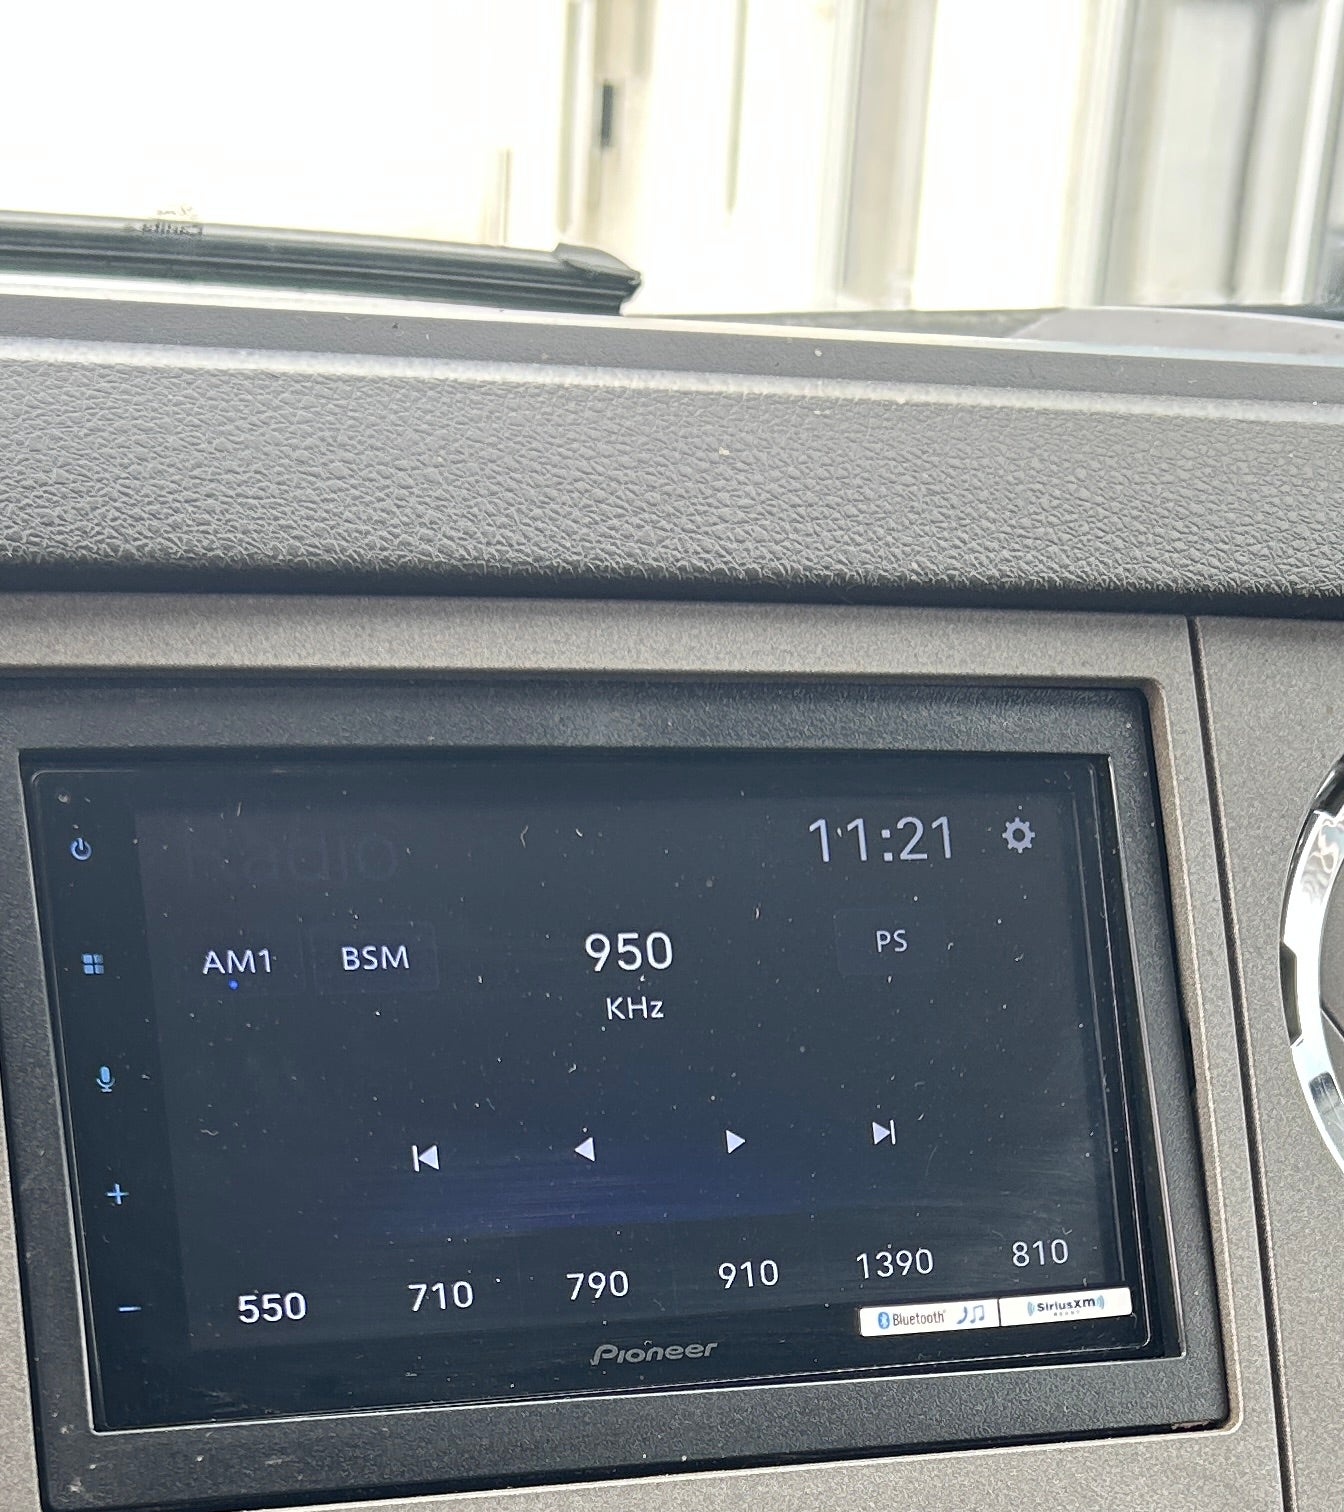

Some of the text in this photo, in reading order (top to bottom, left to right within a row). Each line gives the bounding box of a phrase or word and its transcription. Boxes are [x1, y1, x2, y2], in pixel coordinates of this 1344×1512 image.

[808, 815, 952, 863] 11:21
[584, 931, 674, 973] 950
[875, 929, 908, 953] PS
[202, 948, 272, 975] AM1
[340, 945, 410, 971] BSM
[605, 995, 665, 1021] KHz
[237, 1238, 1069, 1324] 550 710 790 910 1390 810
[892, 1311, 945, 1327] Bluetooth
[589, 1341, 719, 1367] Pioneer
